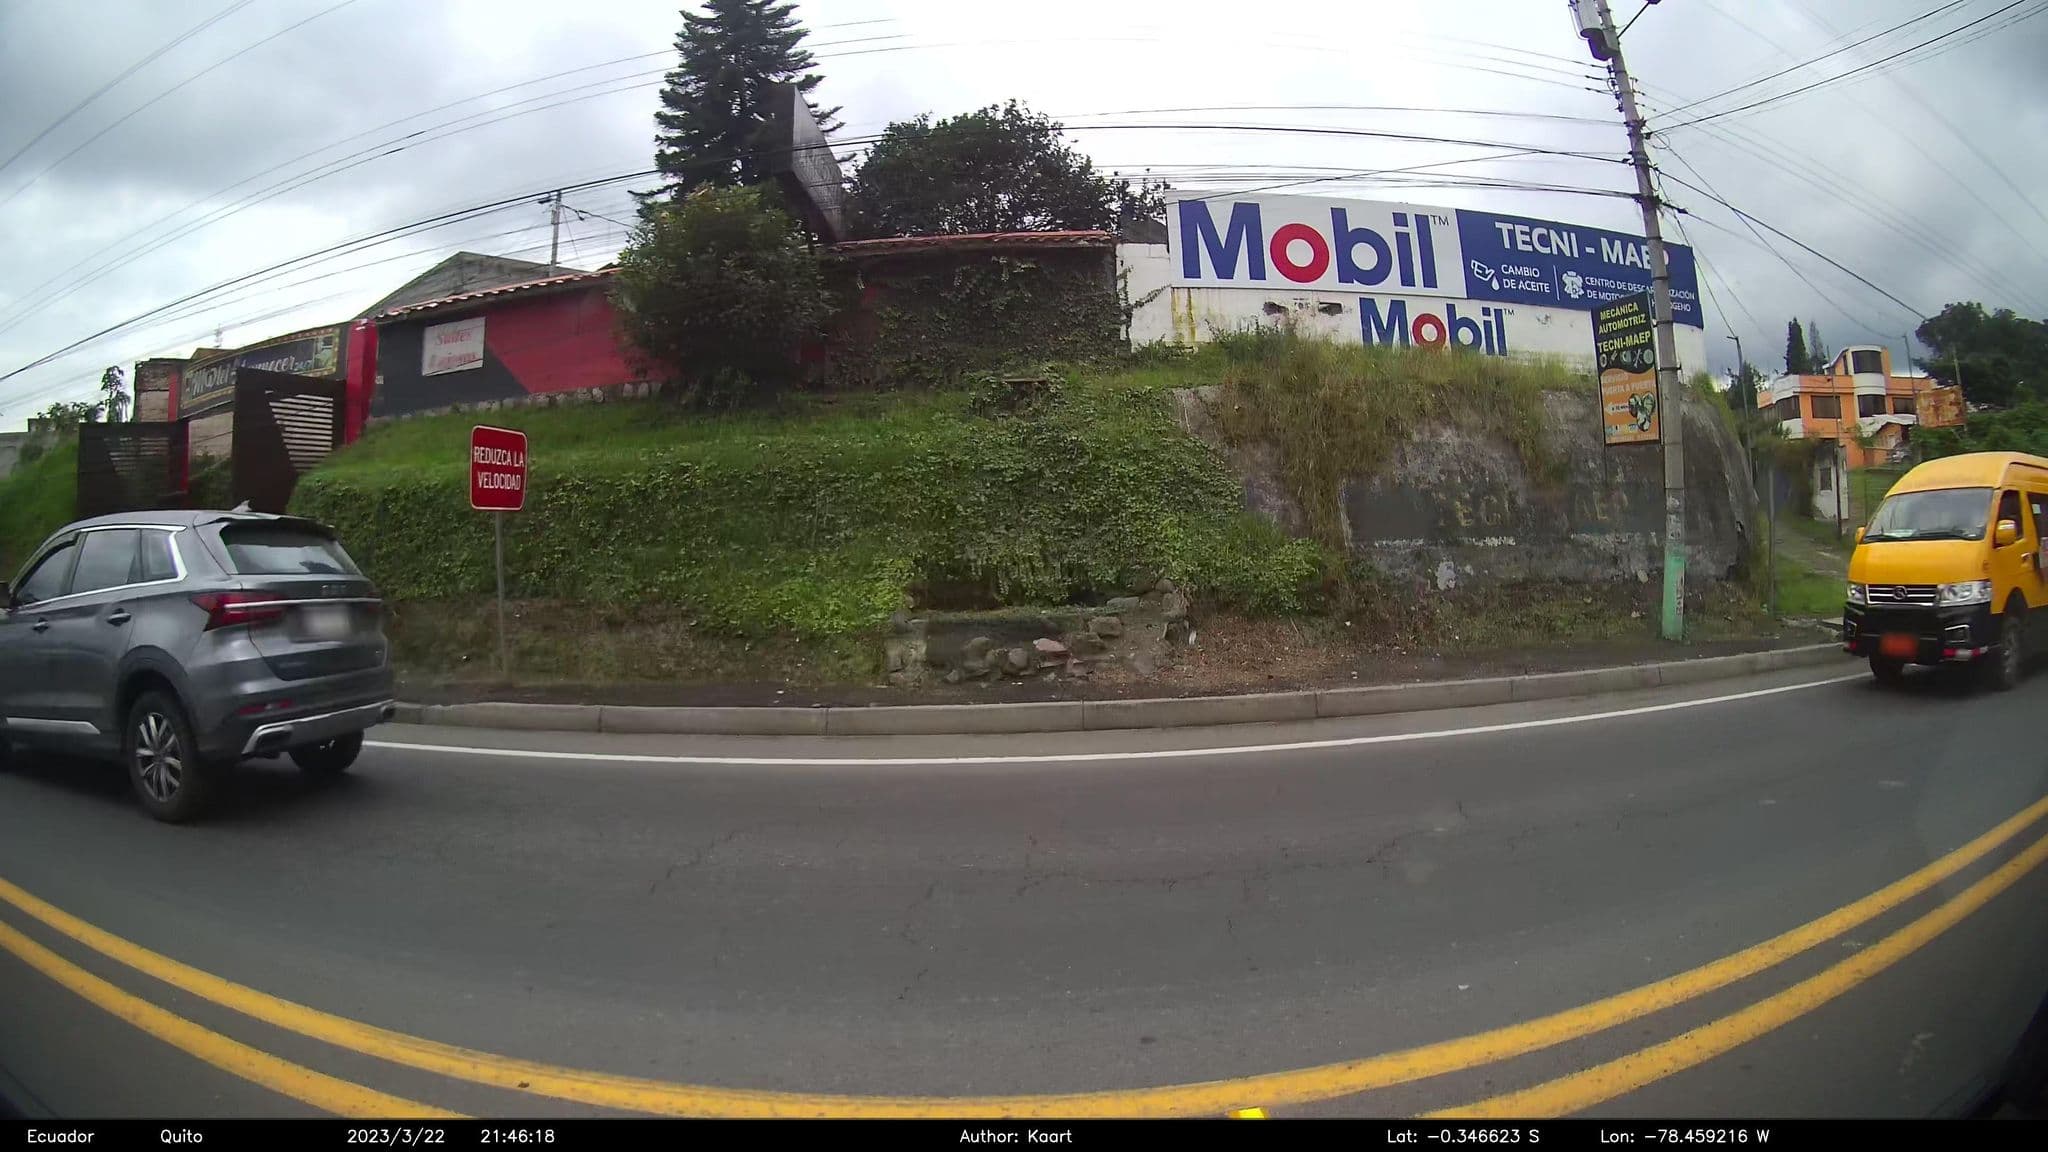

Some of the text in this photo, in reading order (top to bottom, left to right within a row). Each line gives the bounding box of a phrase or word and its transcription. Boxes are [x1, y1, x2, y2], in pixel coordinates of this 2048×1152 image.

[1178, 200, 1438, 289] Mobil
[1494, 221, 1579, 258] TECNI
[1501, 264, 1540, 277] CAMBIO
[1502, 278, 1551, 292] DE ACEITE
[1585, 276, 1616, 289] CENTRO
[1616, 281, 1628, 290] DE
[1587, 290, 1598, 299] DE
[1358, 297, 1508, 356] Mobil
[1598, 314, 1646, 335] AUTOMOTRIZ
[1597, 331, 1651, 353] TECNI-MAEP
[474, 446, 525, 467] REDUZCA LA
[478, 472, 521, 490] VELOCIDAD
